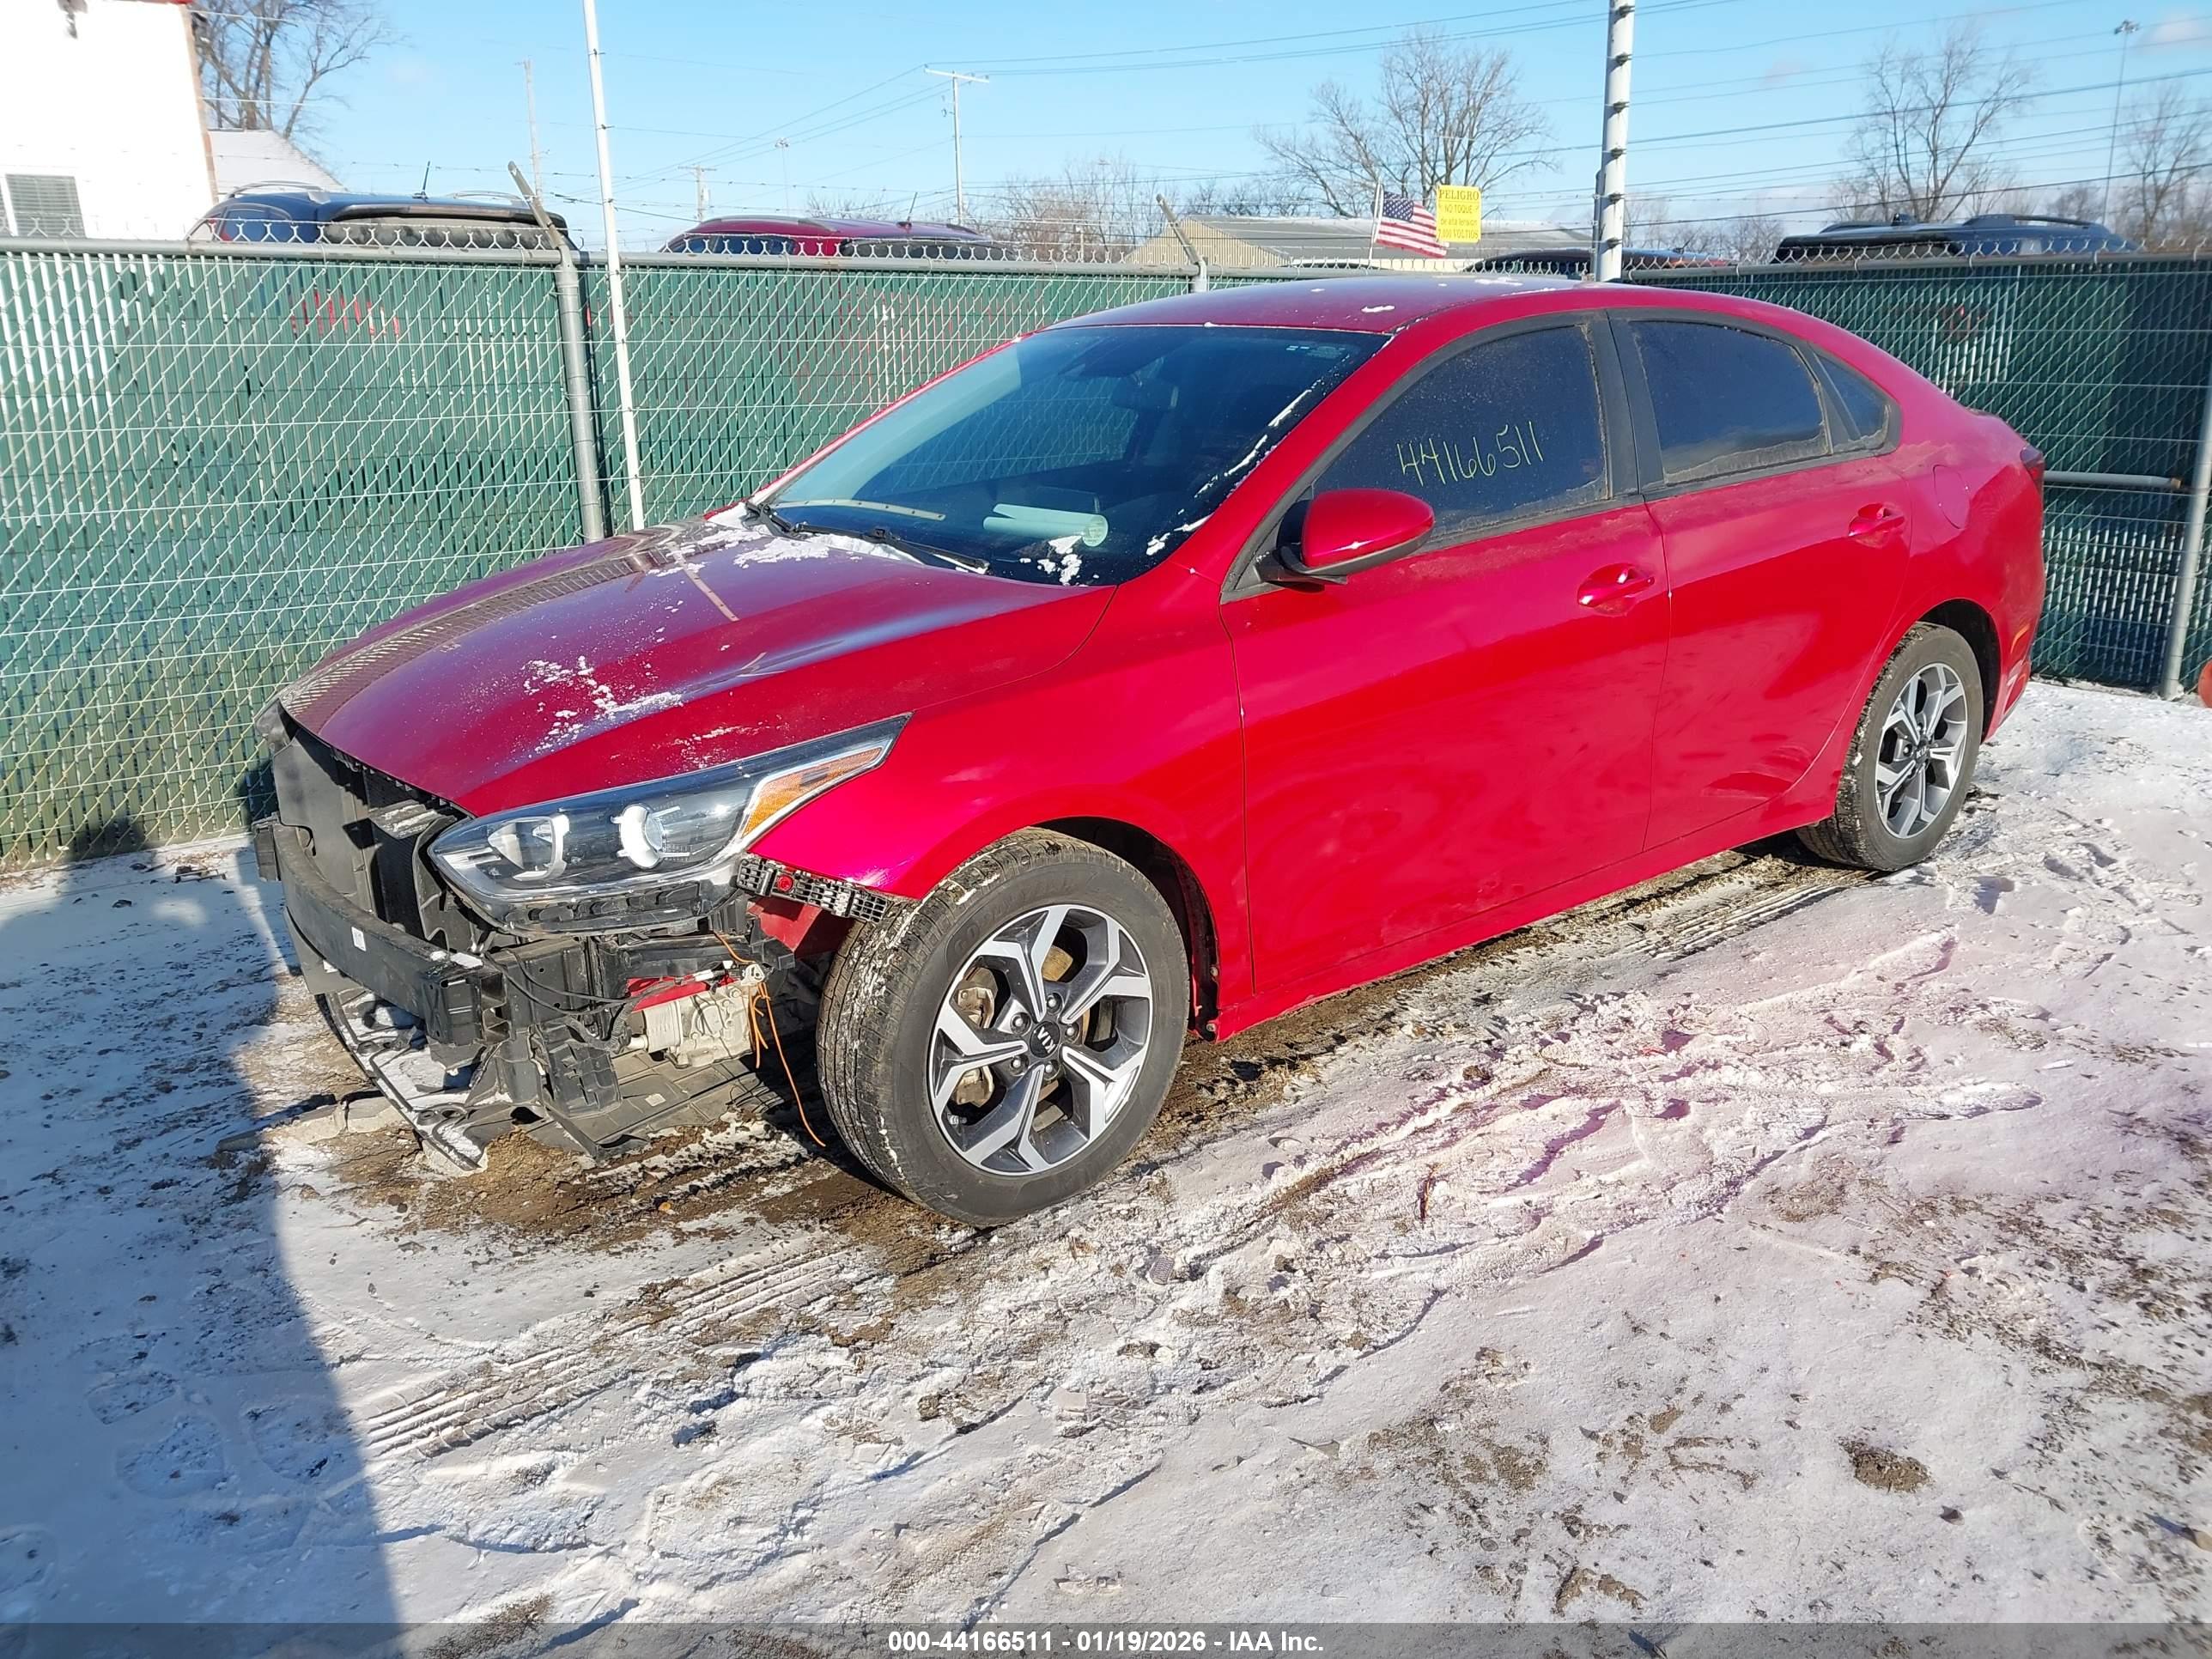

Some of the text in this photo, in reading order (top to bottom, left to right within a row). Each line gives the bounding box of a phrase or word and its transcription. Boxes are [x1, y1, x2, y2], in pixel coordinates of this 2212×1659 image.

[1439, 189, 1480, 201] PELIGRO
[1444, 204, 1473, 214] NO TOQUE
[1453, 228, 1479, 239] VOLTIOS
[1397, 421, 1544, 487] 44166511
[1037, 1026, 1056, 1054] KIA
